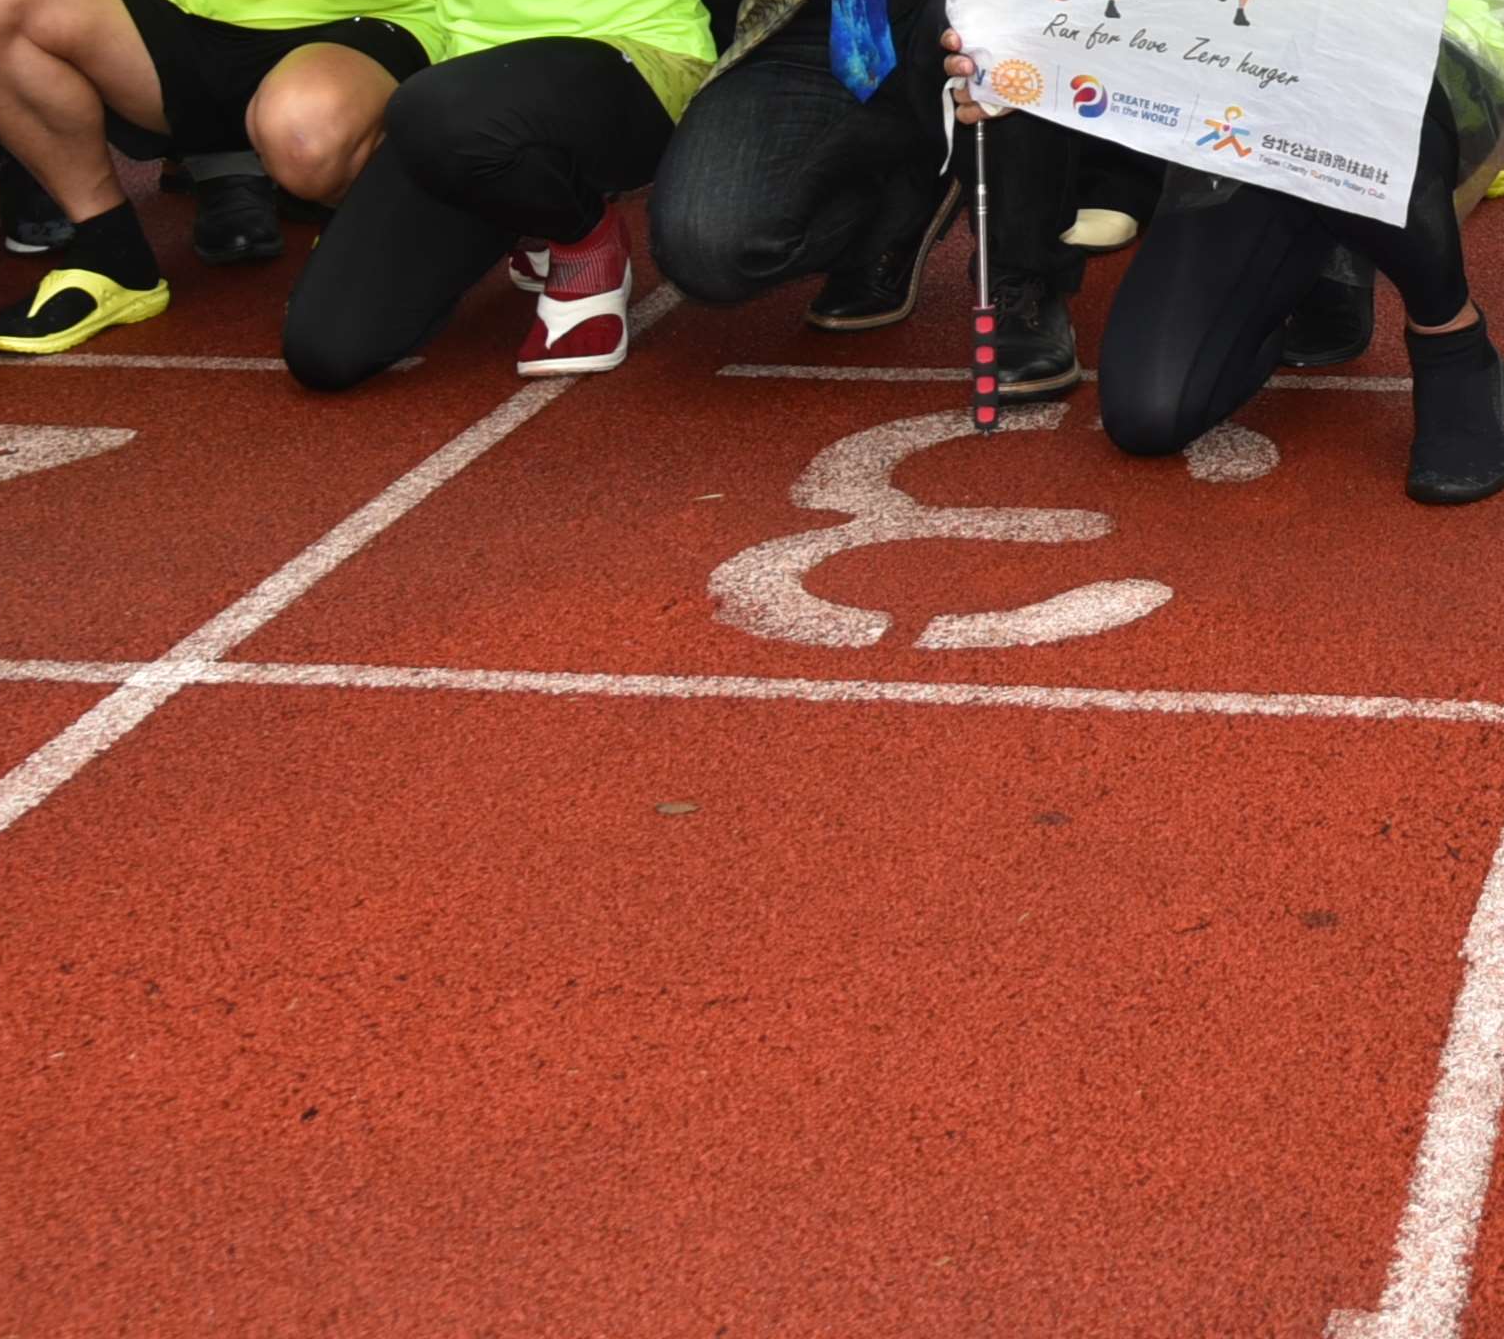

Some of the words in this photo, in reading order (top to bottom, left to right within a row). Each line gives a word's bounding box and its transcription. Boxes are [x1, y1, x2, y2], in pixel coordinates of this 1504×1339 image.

[1086, 22, 1121, 50] for
[1129, 30, 1168, 54] love
[1182, 37, 1230, 68] Zero
[1235, 52, 1301, 89] hunger
[1111, 92, 1150, 110] CREATE
[1152, 100, 1181, 117] HOPE
[1123, 106, 1139, 119] the
[1140, 109, 1179, 128] WORLD
[1261, 134, 1389, 186] 台北公益路跑扶輪社
